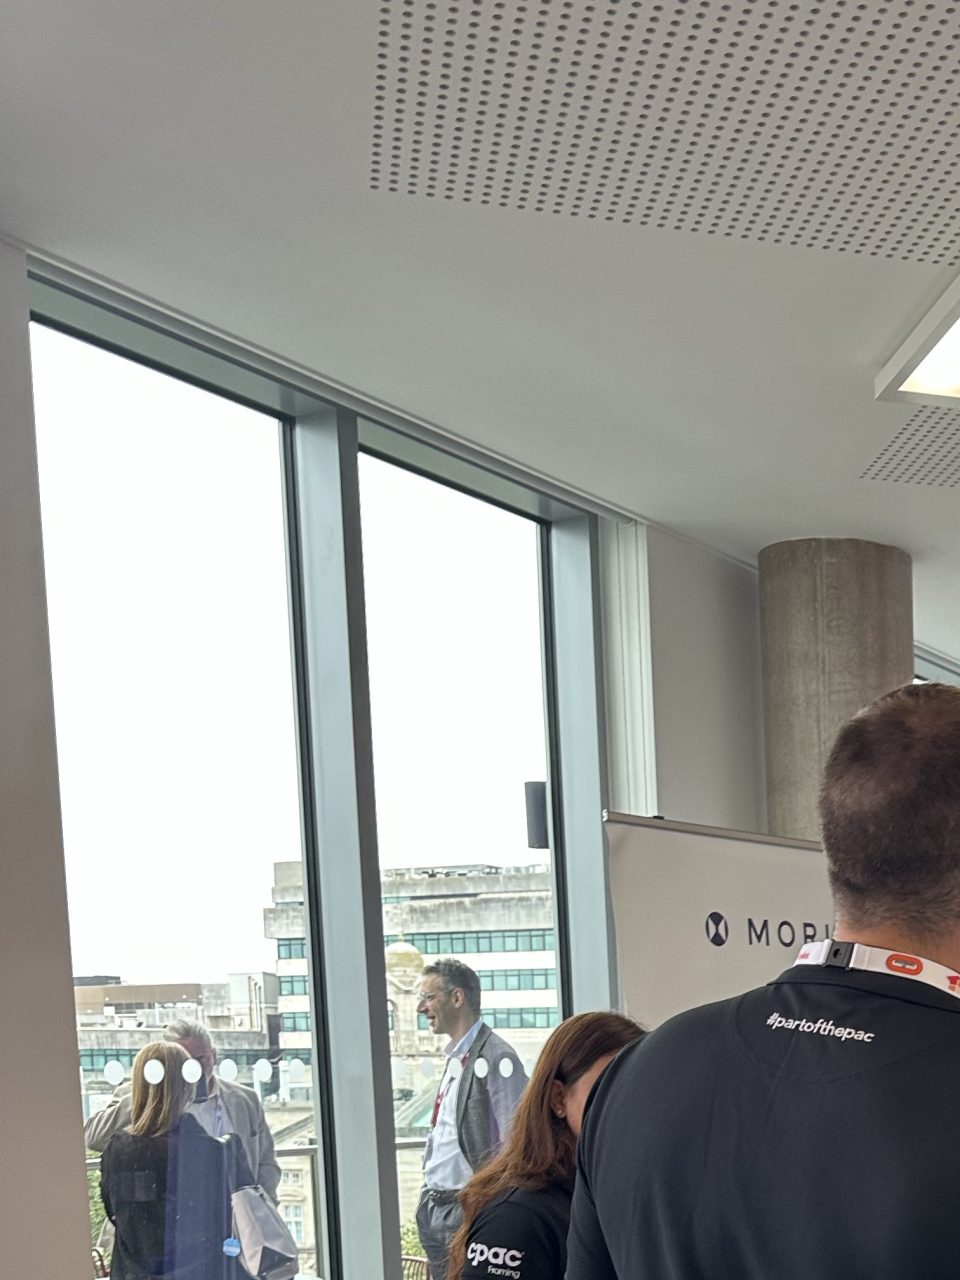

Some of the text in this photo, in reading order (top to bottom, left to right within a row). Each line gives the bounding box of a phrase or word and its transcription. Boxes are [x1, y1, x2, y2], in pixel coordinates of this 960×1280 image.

[766, 1012, 875, 1042] #partofthepac
[467, 1242, 522, 1266] cpac
[487, 1265, 521, 1280] Framing
